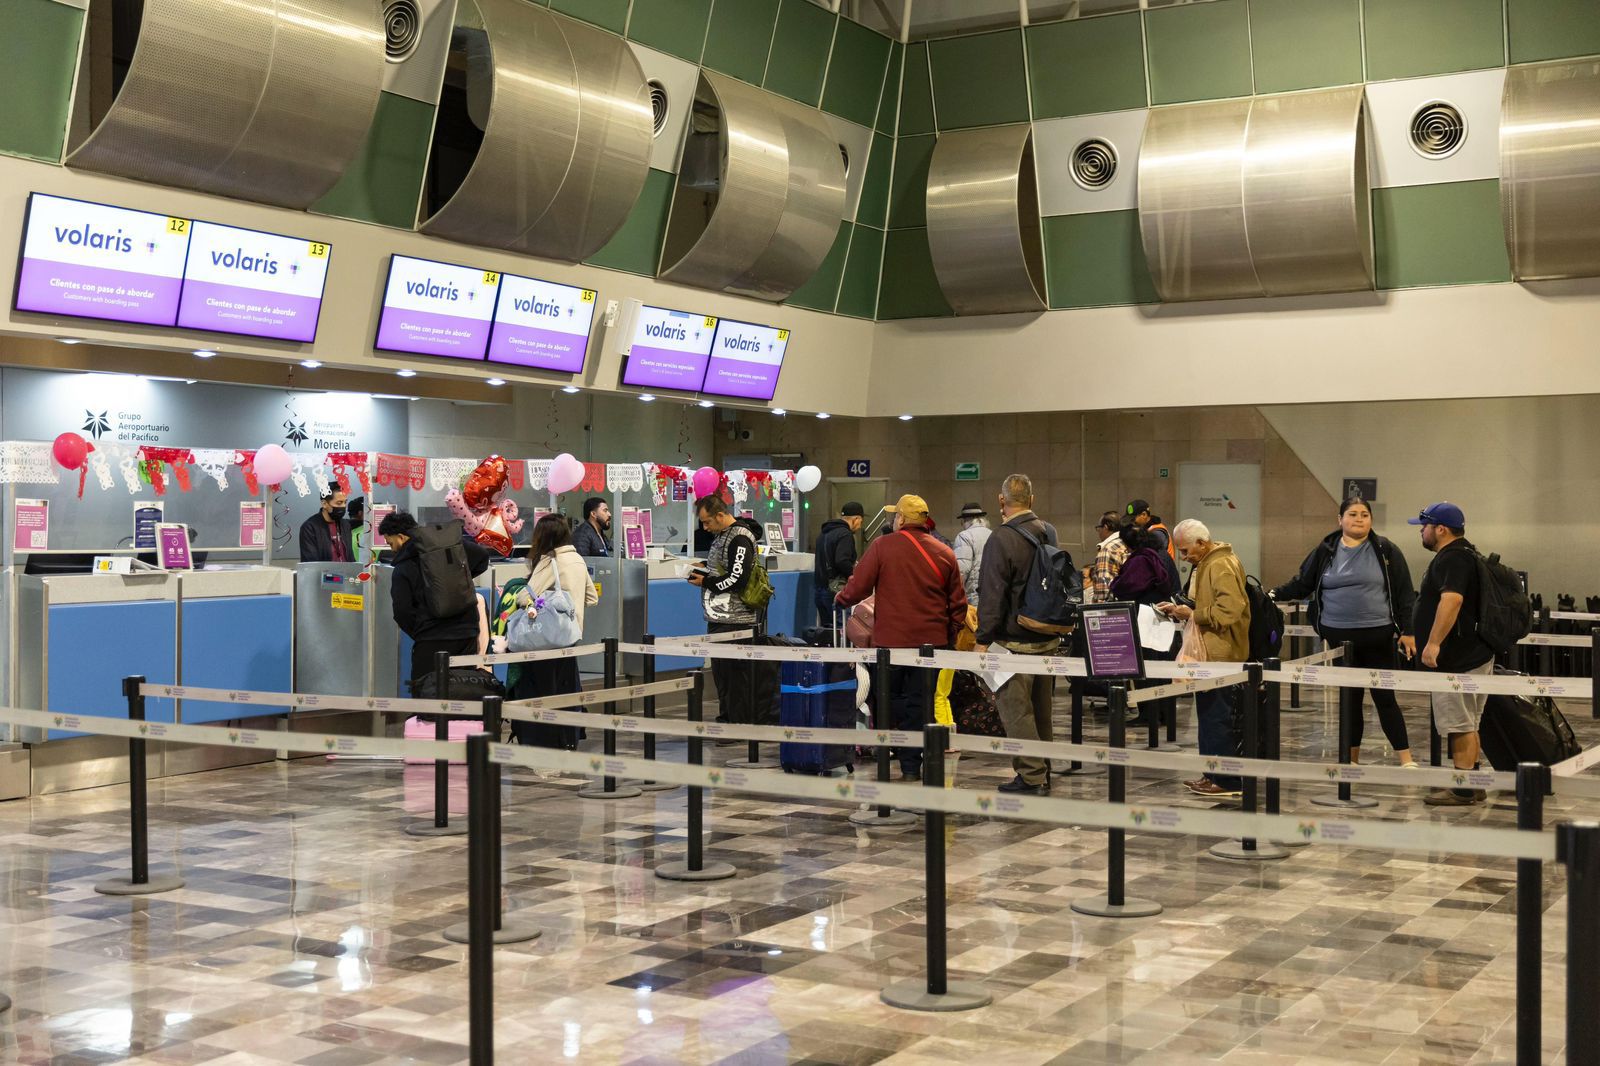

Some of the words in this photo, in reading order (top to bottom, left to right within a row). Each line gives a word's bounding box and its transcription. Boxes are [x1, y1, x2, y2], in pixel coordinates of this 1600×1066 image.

[170, 220, 185, 232] 12
[54, 224, 132, 252] volaris
[312, 244, 324, 256] 13
[211, 248, 278, 275] volaris
[485, 273, 496, 283] 14
[50, 278, 80, 290] Clientes
[82, 284, 96, 292] con
[97, 285, 114, 295] pase
[115, 286, 125, 296] de
[127, 287, 155, 299] abordar
[406, 278, 459, 301] volaris
[104, 296, 127, 307] boarding
[583, 291, 592, 300] 15
[206, 298, 232, 309] Clientes
[246, 304, 261, 313] pase
[262, 305, 271, 313] de
[272, 305, 296, 317] abordar
[514, 296, 560, 317] volaris
[705, 318, 714, 327] 16
[400, 323, 421, 332] Clientes
[452, 330, 472, 338] abordar
[646, 320, 686, 341] volaris
[779, 330, 786, 339] 17
[508, 336, 527, 346] Clientes
[724, 334, 760, 352] volaris
[118, 412, 141, 421] Grupo
[118, 422, 170, 432] Aeroportuario
[314, 439, 350, 450] Morelia
[851, 463, 867, 475] 4C
